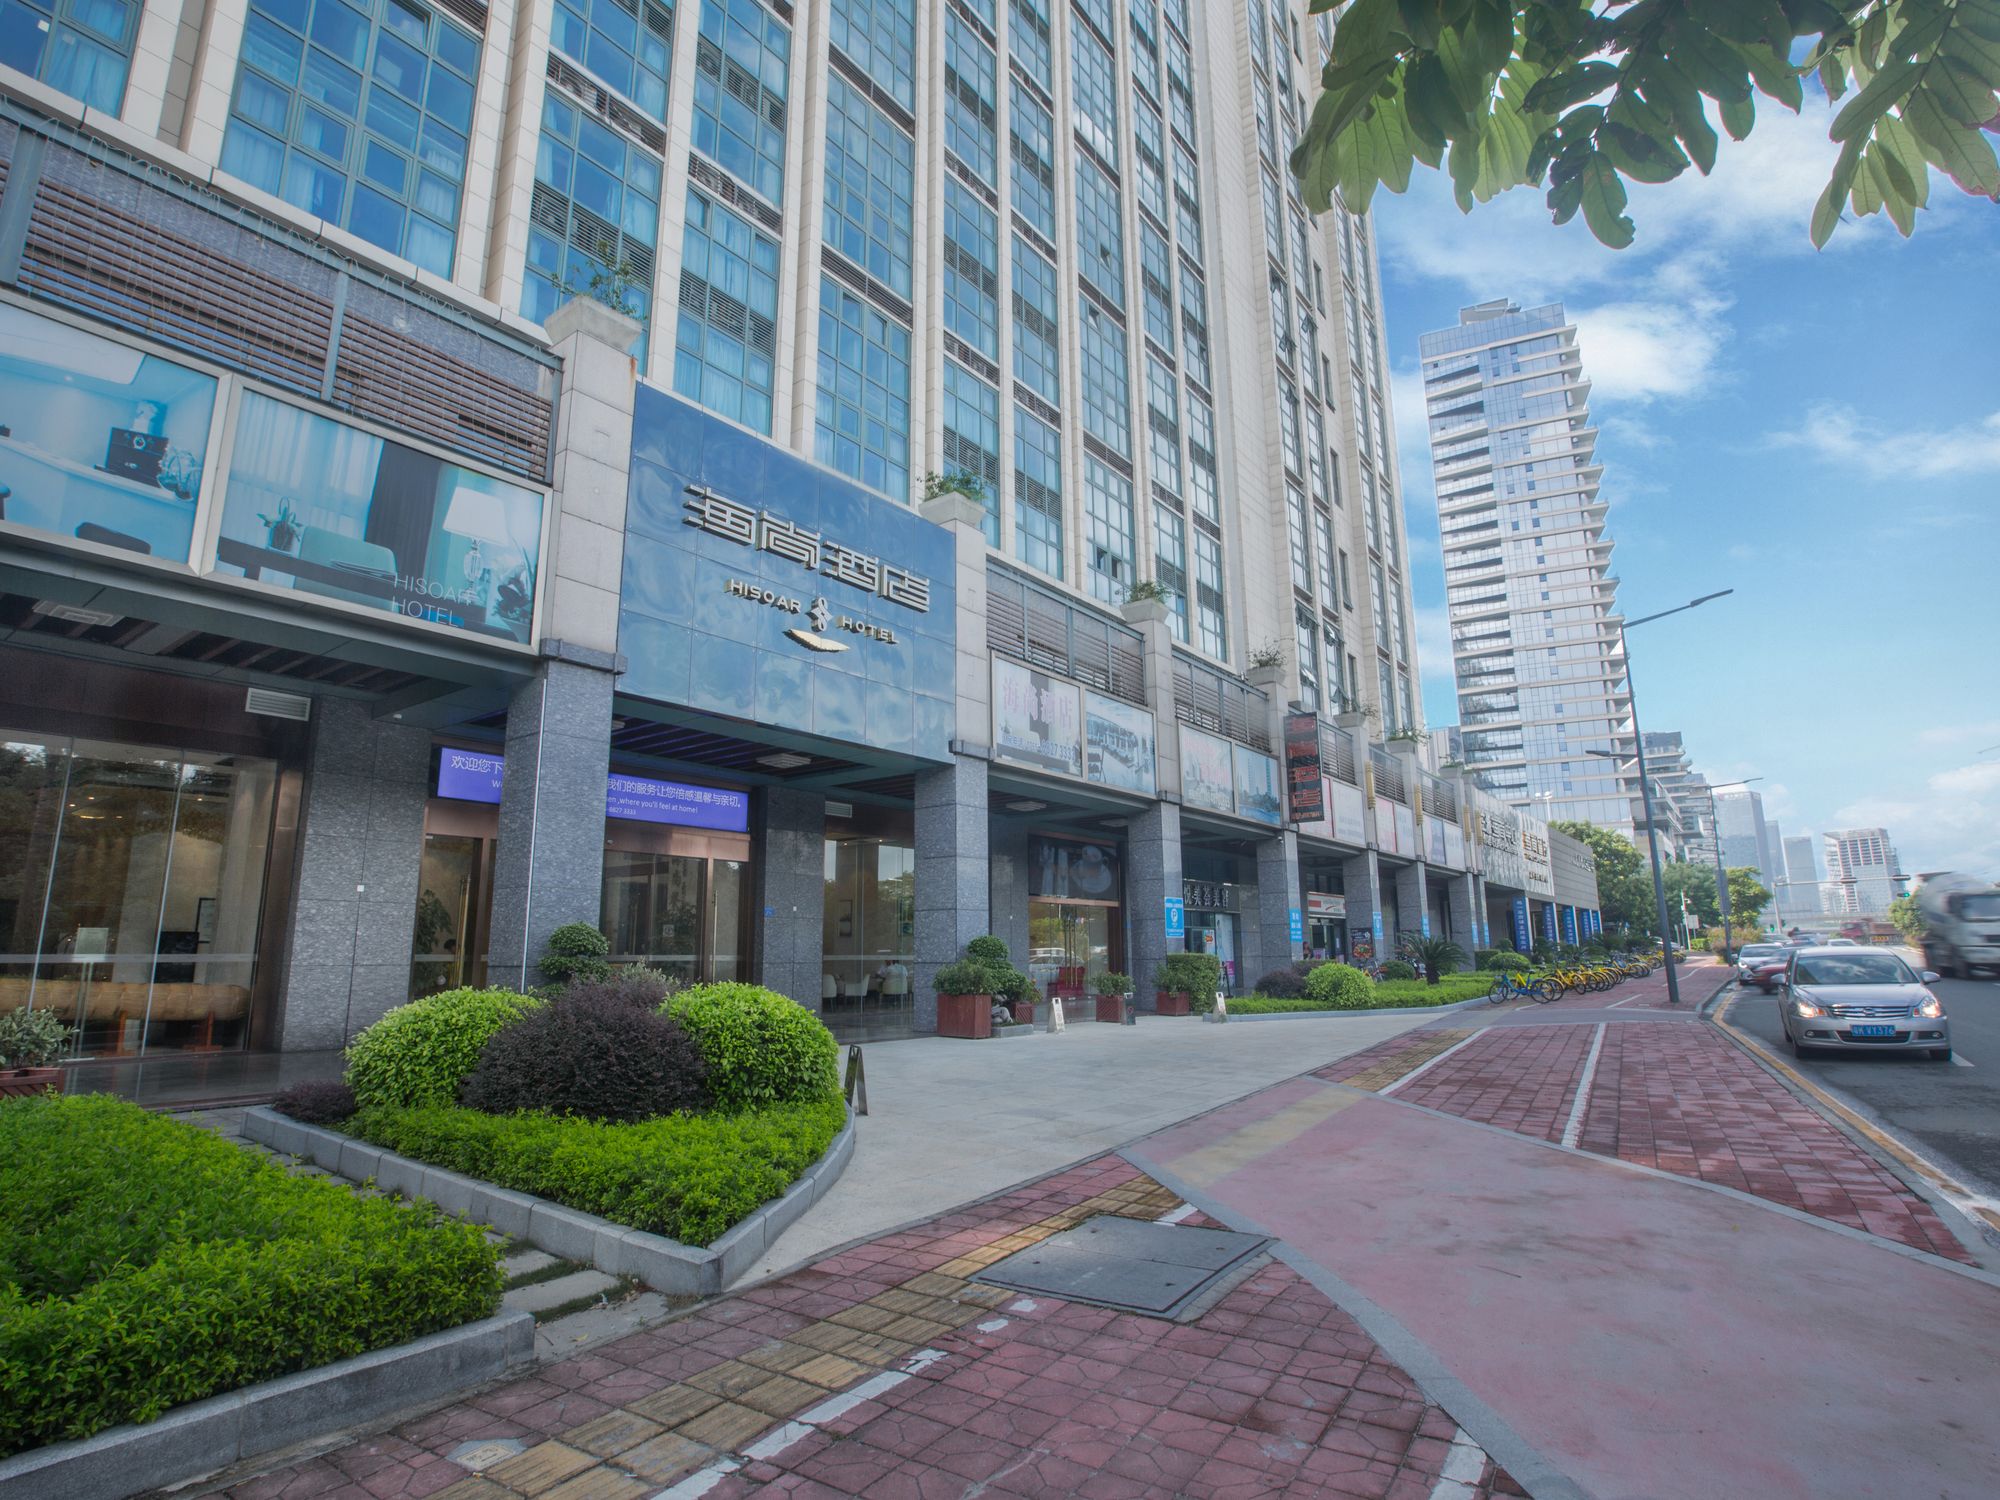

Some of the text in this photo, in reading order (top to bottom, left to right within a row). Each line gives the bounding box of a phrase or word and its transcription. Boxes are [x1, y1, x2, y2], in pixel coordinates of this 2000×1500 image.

[682, 484, 931, 613] 海尚酒店
[394, 574, 472, 606] HISOAR
[391, 596, 459, 628] HOTEL
[726, 578, 900, 645] HISOAR HOTEL
[451, 755, 503, 775] 欢迎您下
[659, 802, 671, 811] feel
[672, 804, 679, 812] at
